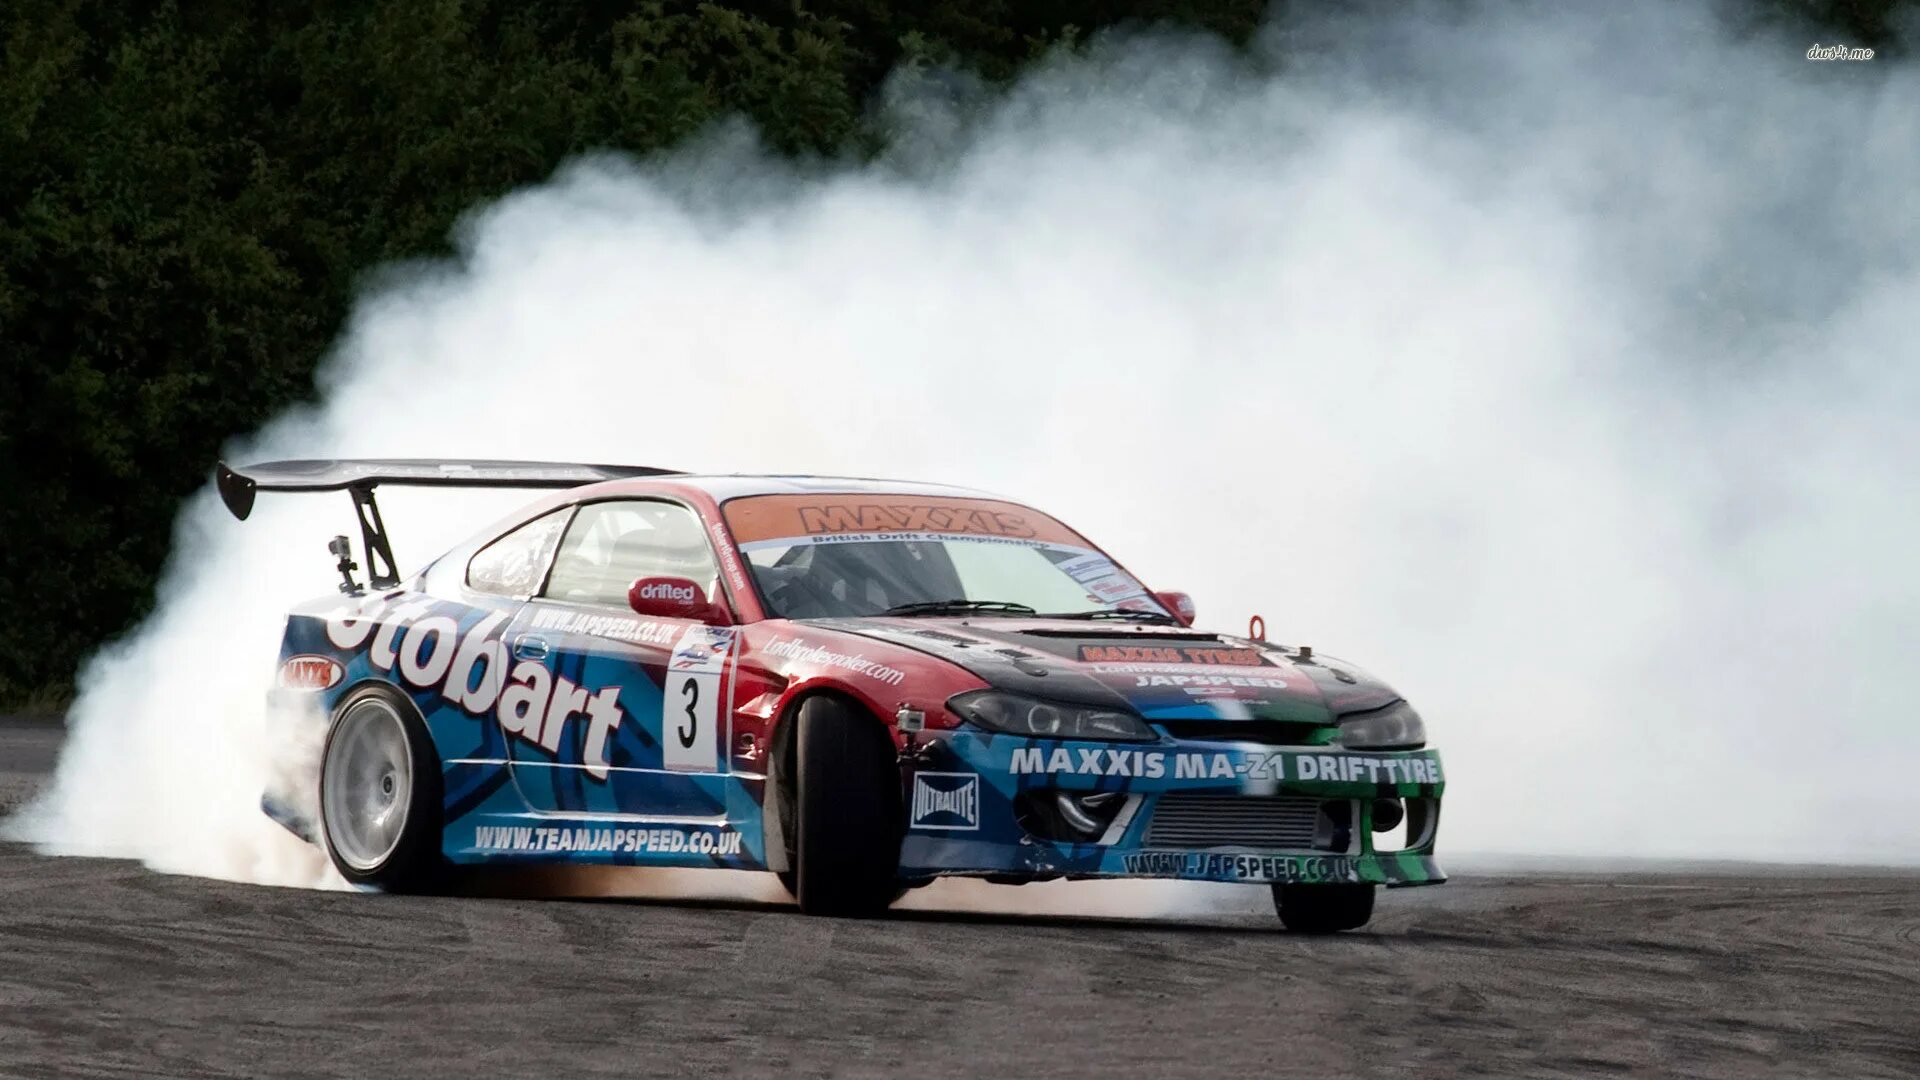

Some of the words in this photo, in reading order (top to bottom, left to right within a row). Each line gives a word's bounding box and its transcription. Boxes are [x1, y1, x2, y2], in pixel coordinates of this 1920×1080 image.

[798, 505, 1036, 539] MAXXIS
[812, 533, 872, 543] British
[877, 532, 920, 541] Drift
[925, 533, 1050, 550] Championship
[641, 583, 695, 600] drifted
[530, 607, 681, 645] WWW.JAPSPEED.CO.UK
[763, 634, 906, 686] Ladbrokespoker.com
[1136, 674, 1288, 689] JAPSPEED
[677, 677, 699, 749] 3
[1009, 748, 1165, 779] MAXXIS
[1174, 752, 1286, 780] MA-Z1
[475, 825, 742, 855] WWW.TEAMJAPSPEED.CO.UK
[1122, 852, 1361, 884] WWW.JAPSPEED.CO.UK
